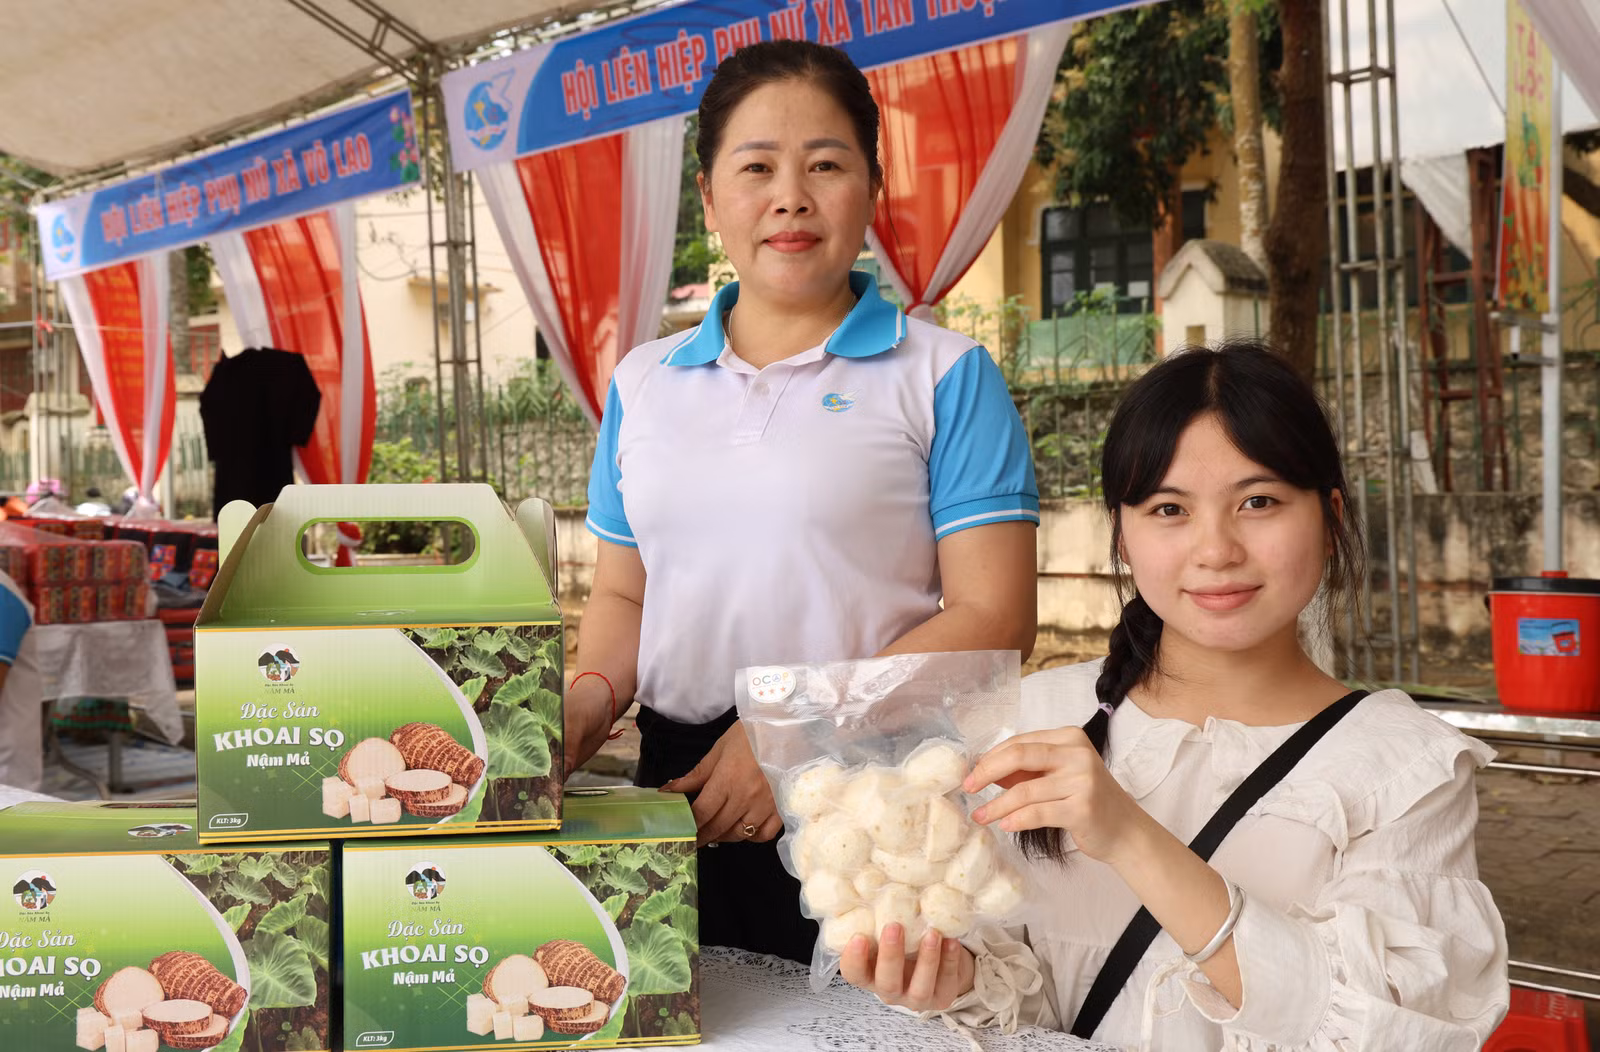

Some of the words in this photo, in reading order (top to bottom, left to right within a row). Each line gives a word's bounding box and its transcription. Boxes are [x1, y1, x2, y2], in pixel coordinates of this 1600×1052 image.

[561, 59, 599, 120] HỘI
[602, 46, 652, 105] LIÊN
[655, 29, 706, 93] HIỆP
[128, 193, 165, 234] LIÊN
[165, 181, 201, 228] HIỆP
[204, 173, 241, 215] PHỤ
[242, 156, 270, 204] NỮ
[272, 149, 302, 195] XÃ
[332, 132, 372, 178] LAO
[240, 702, 278, 723] Đặc
[283, 700, 320, 719] Sản
[212, 726, 302, 752] KHOAI
[309, 727, 345, 751] SỌ
[247, 753, 283, 769] Nậm
[286, 751, 310, 766] Mả
[37, 929, 77, 948] Sản
[387, 919, 425, 941] Đặc
[429, 918, 466, 937] Sản
[0, 955, 56, 977] OAI
[64, 957, 102, 981] SỌ
[361, 944, 447, 970] KHOAI
[454, 944, 490, 968] SỌ
[393, 970, 429, 987] Nậm
[431, 967, 456, 984] Mả
[0, 984, 37, 1001] Nậm
[39, 981, 65, 997] Mả
